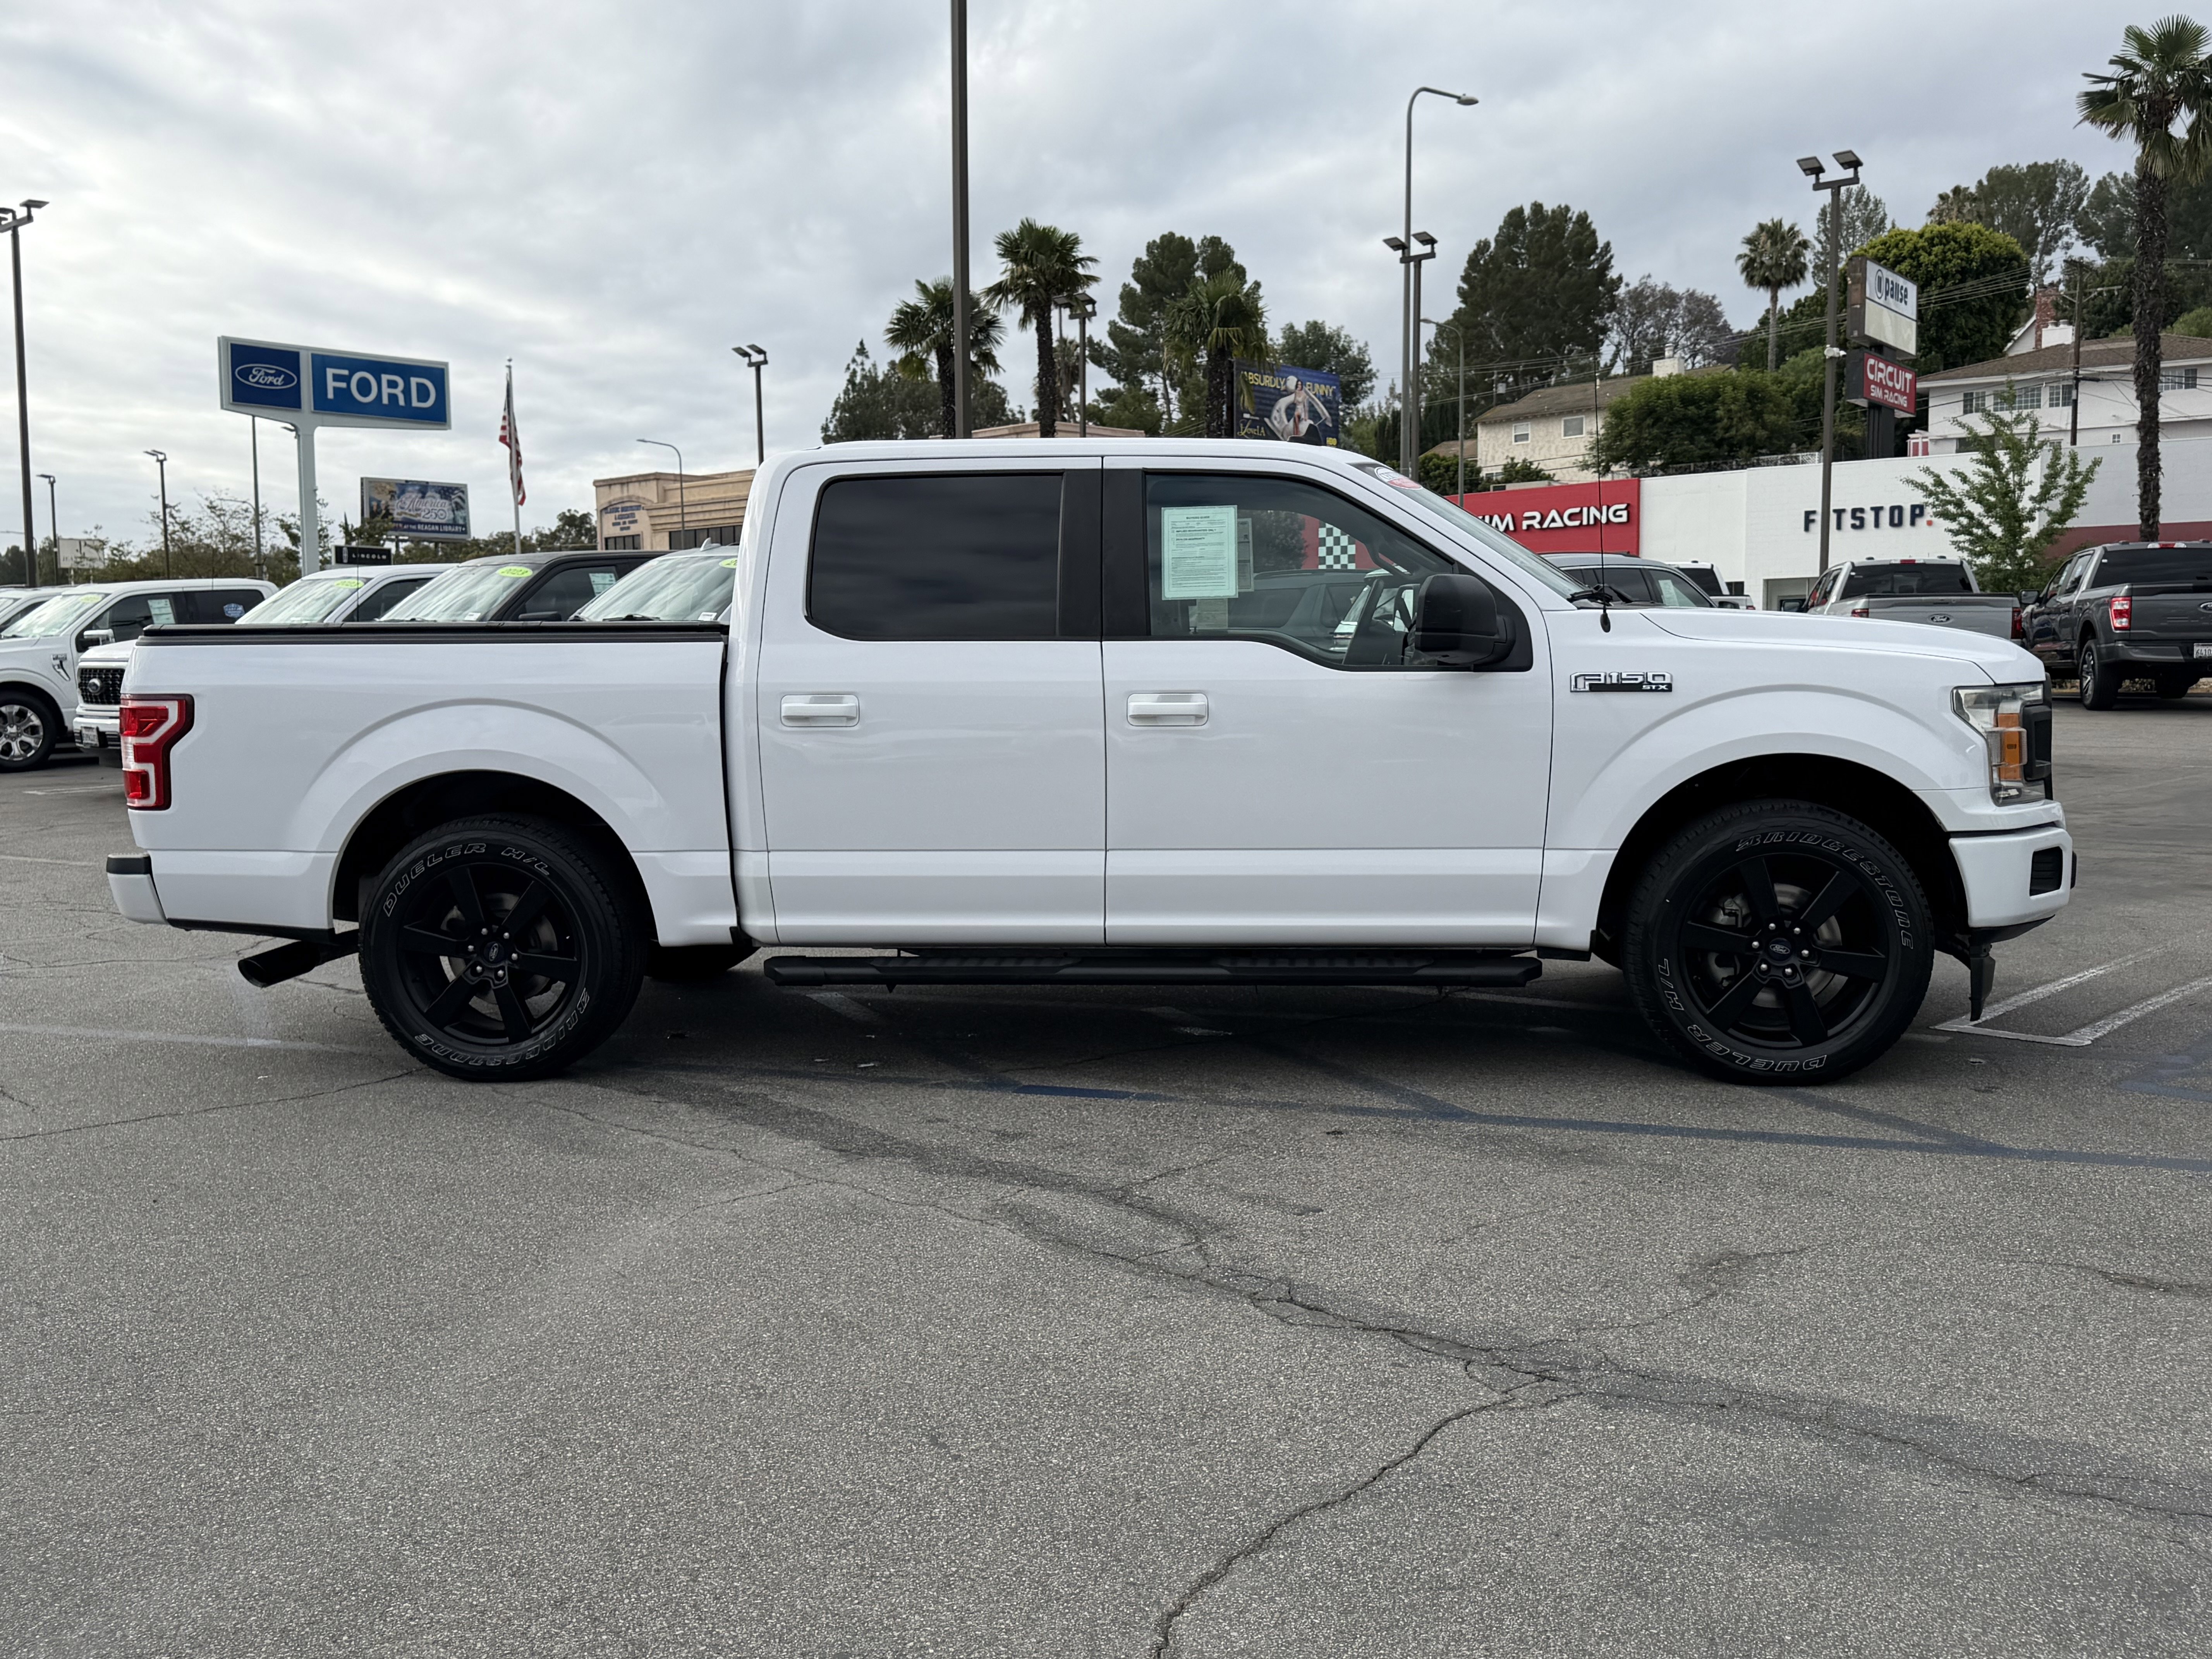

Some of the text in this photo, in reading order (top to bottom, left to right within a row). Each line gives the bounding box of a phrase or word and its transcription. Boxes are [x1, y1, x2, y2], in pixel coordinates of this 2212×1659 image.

[1885, 277, 1908, 305] pause
[249, 367, 284, 386] Ford
[326, 368, 436, 408] FORD
[1867, 358, 1912, 393] CIRCUIT
[1870, 387, 1908, 407] SIM RACING
[396, 496, 447, 512] America
[422, 508, 447, 520] 250
[1522, 503, 1628, 530] RACING
[1804, 504, 1933, 532] FTSTOP.
[383, 843, 550, 917] DUELER H/L
[1736, 831, 1913, 949] BRIDGESTONE
[415, 988, 591, 1067] BRIDGESTONE
[1688, 1024, 1827, 1072] DUELER
